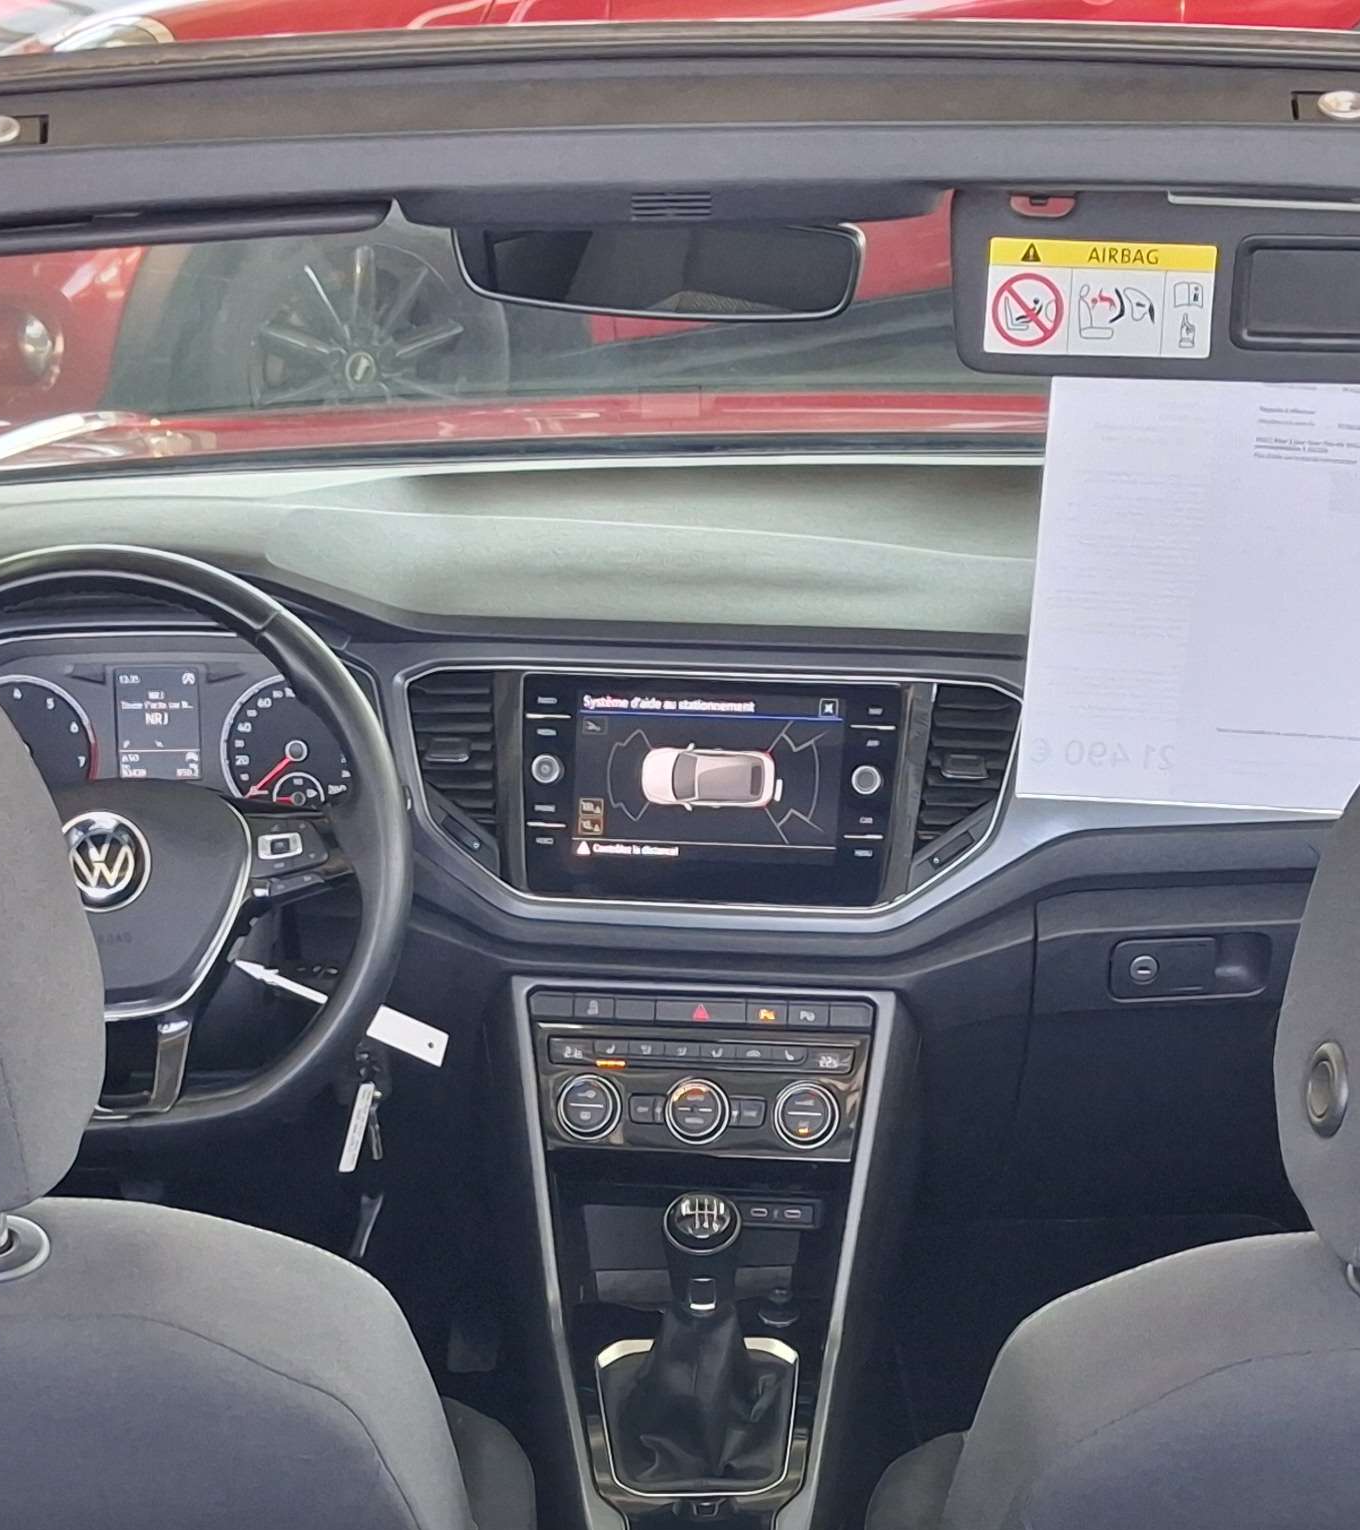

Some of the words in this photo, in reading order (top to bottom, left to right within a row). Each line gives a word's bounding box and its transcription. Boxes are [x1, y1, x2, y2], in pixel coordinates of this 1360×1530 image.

[1087, 247, 1160, 265] AIRBAG
[46, 697, 55, 710] 5
[77, 755, 87, 769] 7
